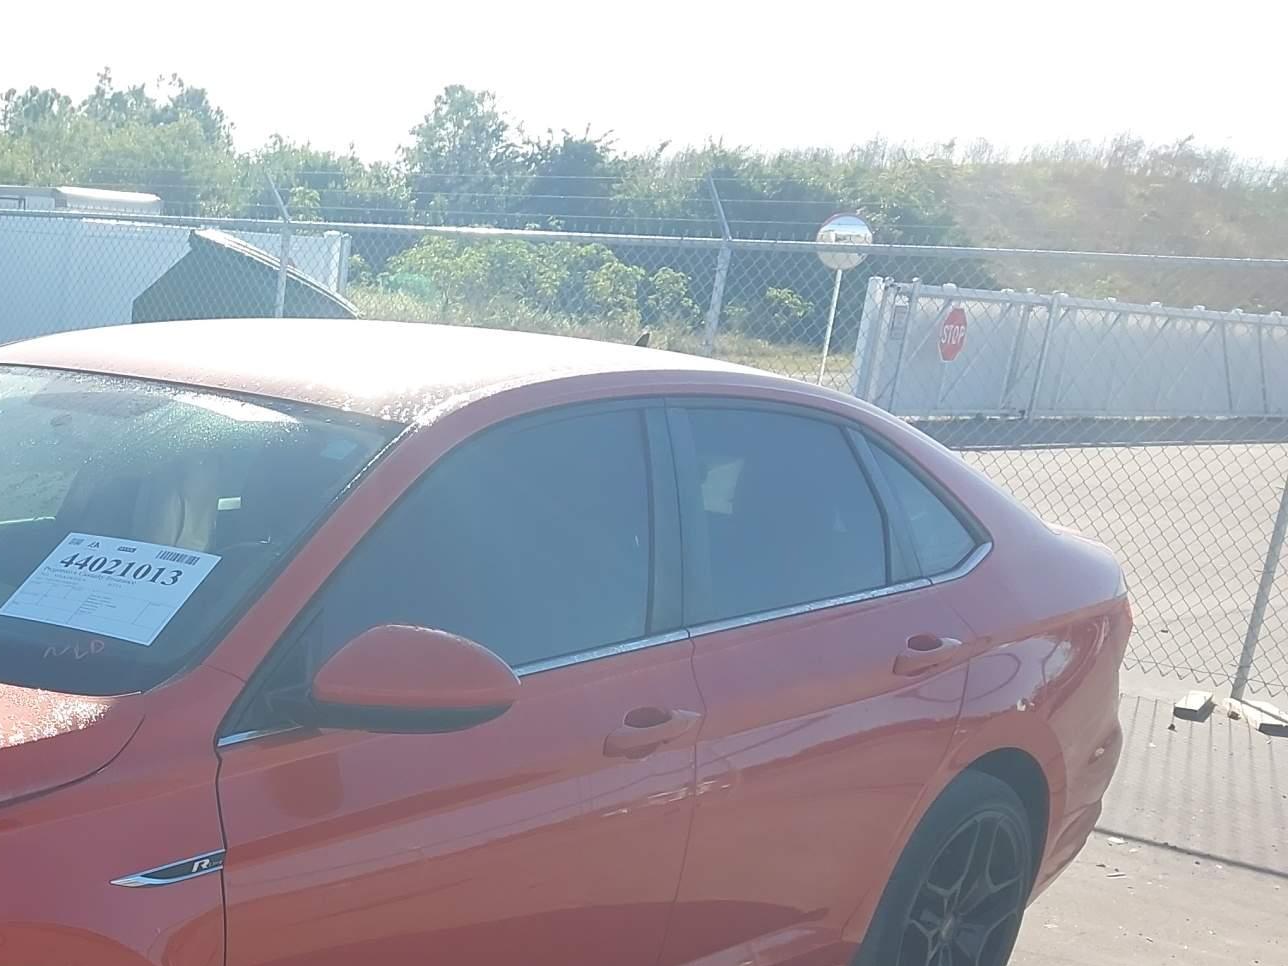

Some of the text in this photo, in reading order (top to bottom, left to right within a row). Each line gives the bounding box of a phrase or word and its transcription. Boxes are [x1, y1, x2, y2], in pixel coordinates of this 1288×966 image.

[941, 325, 966, 345] STOP
[60, 552, 183, 586] 44021013
[192, 858, 210, 873] R
